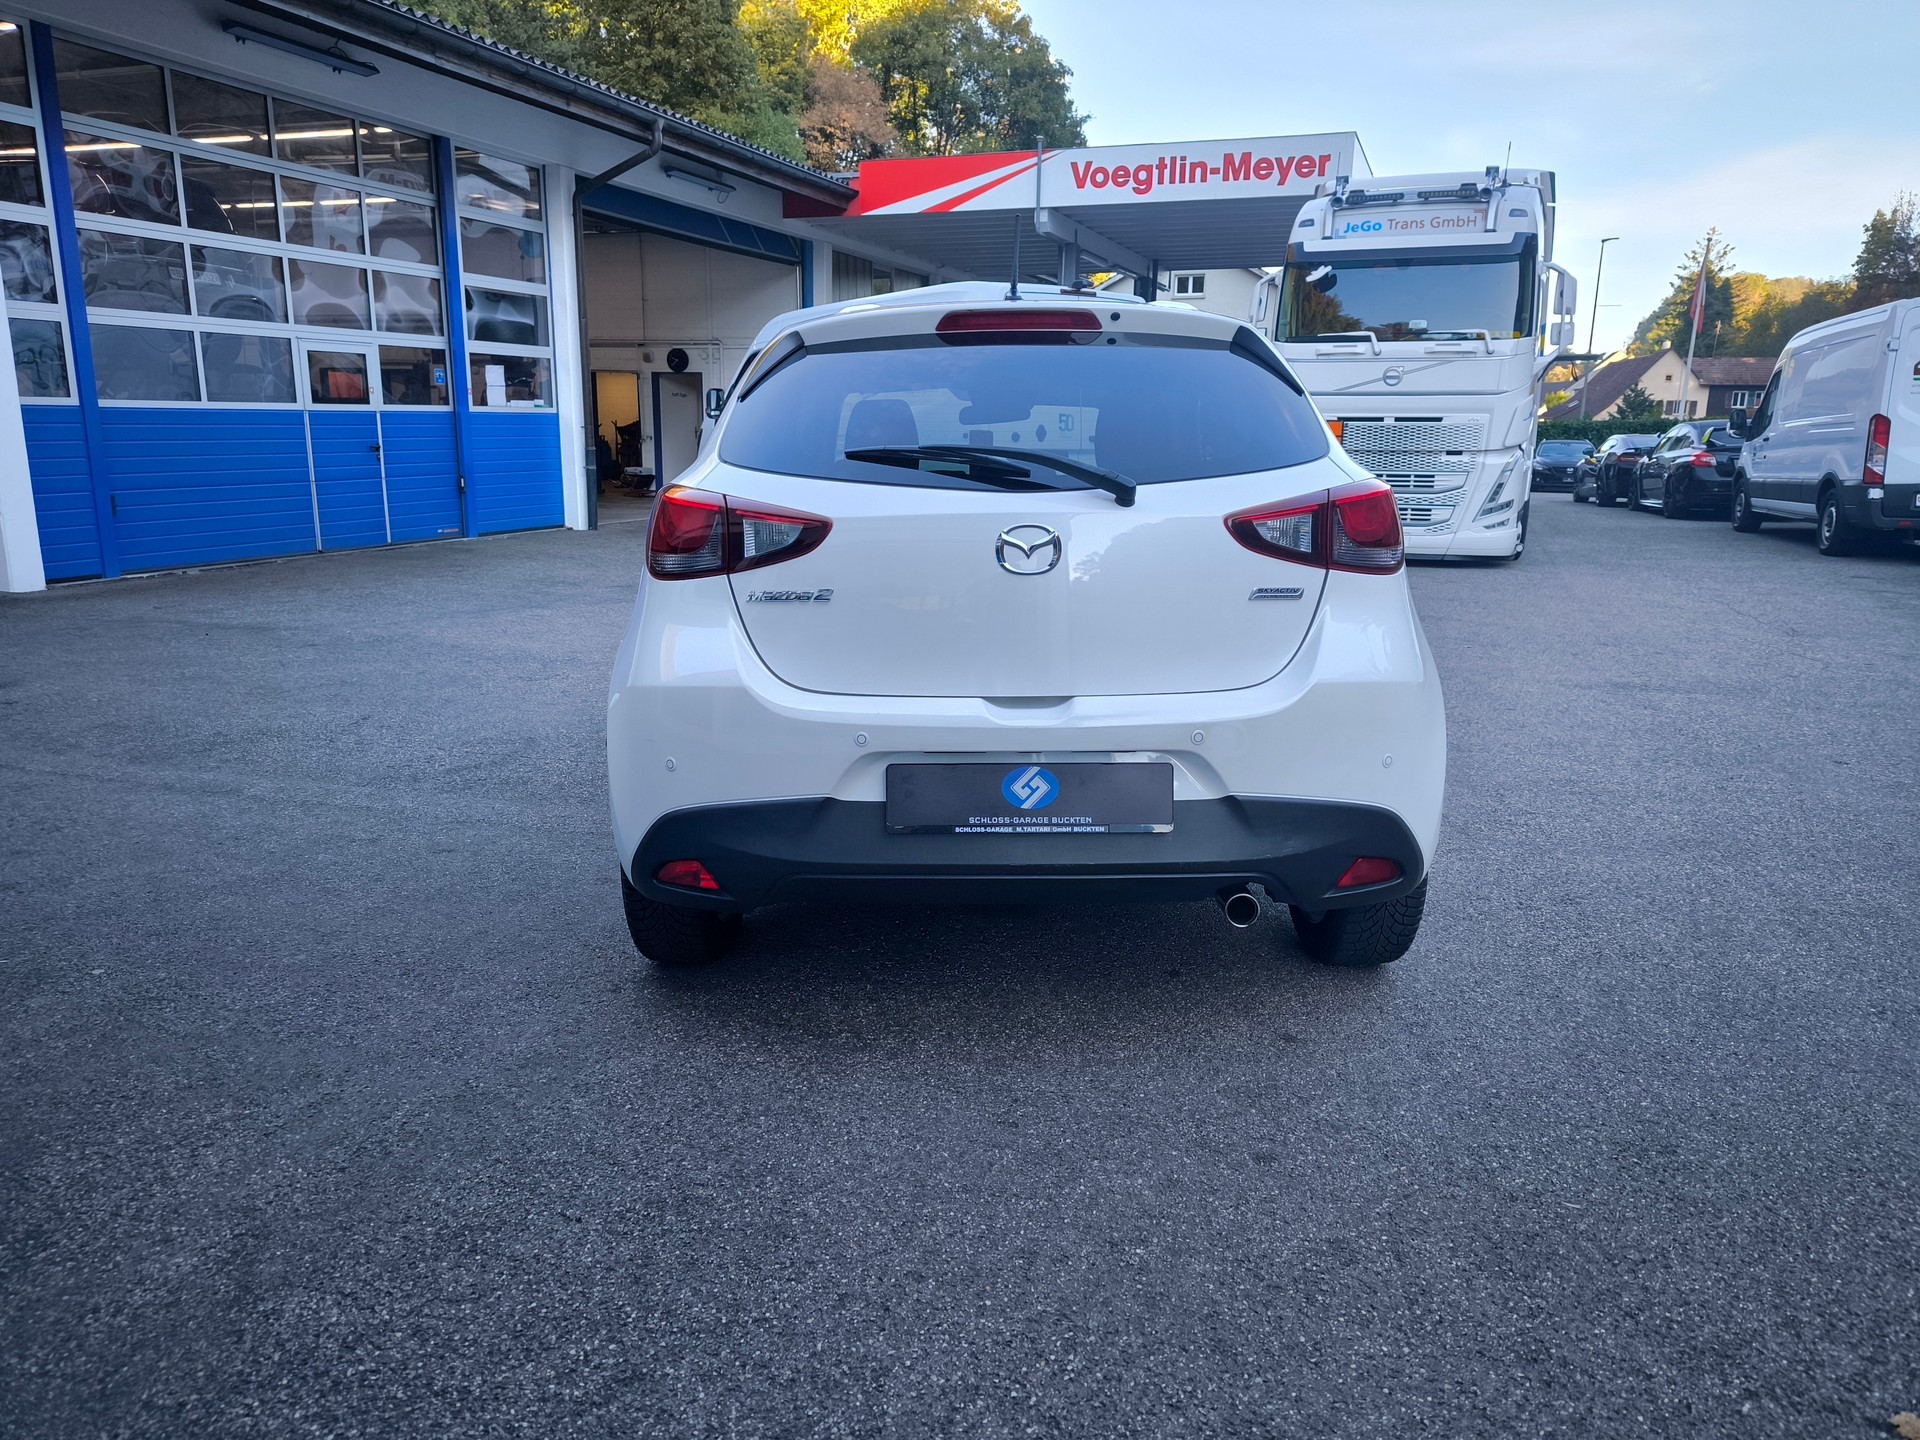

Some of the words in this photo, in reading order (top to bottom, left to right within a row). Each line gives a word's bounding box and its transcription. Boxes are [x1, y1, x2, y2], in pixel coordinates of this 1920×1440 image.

[1070, 151, 1331, 195] Voegtlin-Meyer
[1344, 220, 1382, 234] JeGo
[1387, 218, 1425, 231] Trans
[1430, 215, 1477, 229] GmbH
[1058, 413, 1074, 432] 50
[1052, 816, 1092, 824] BUCKTEN
